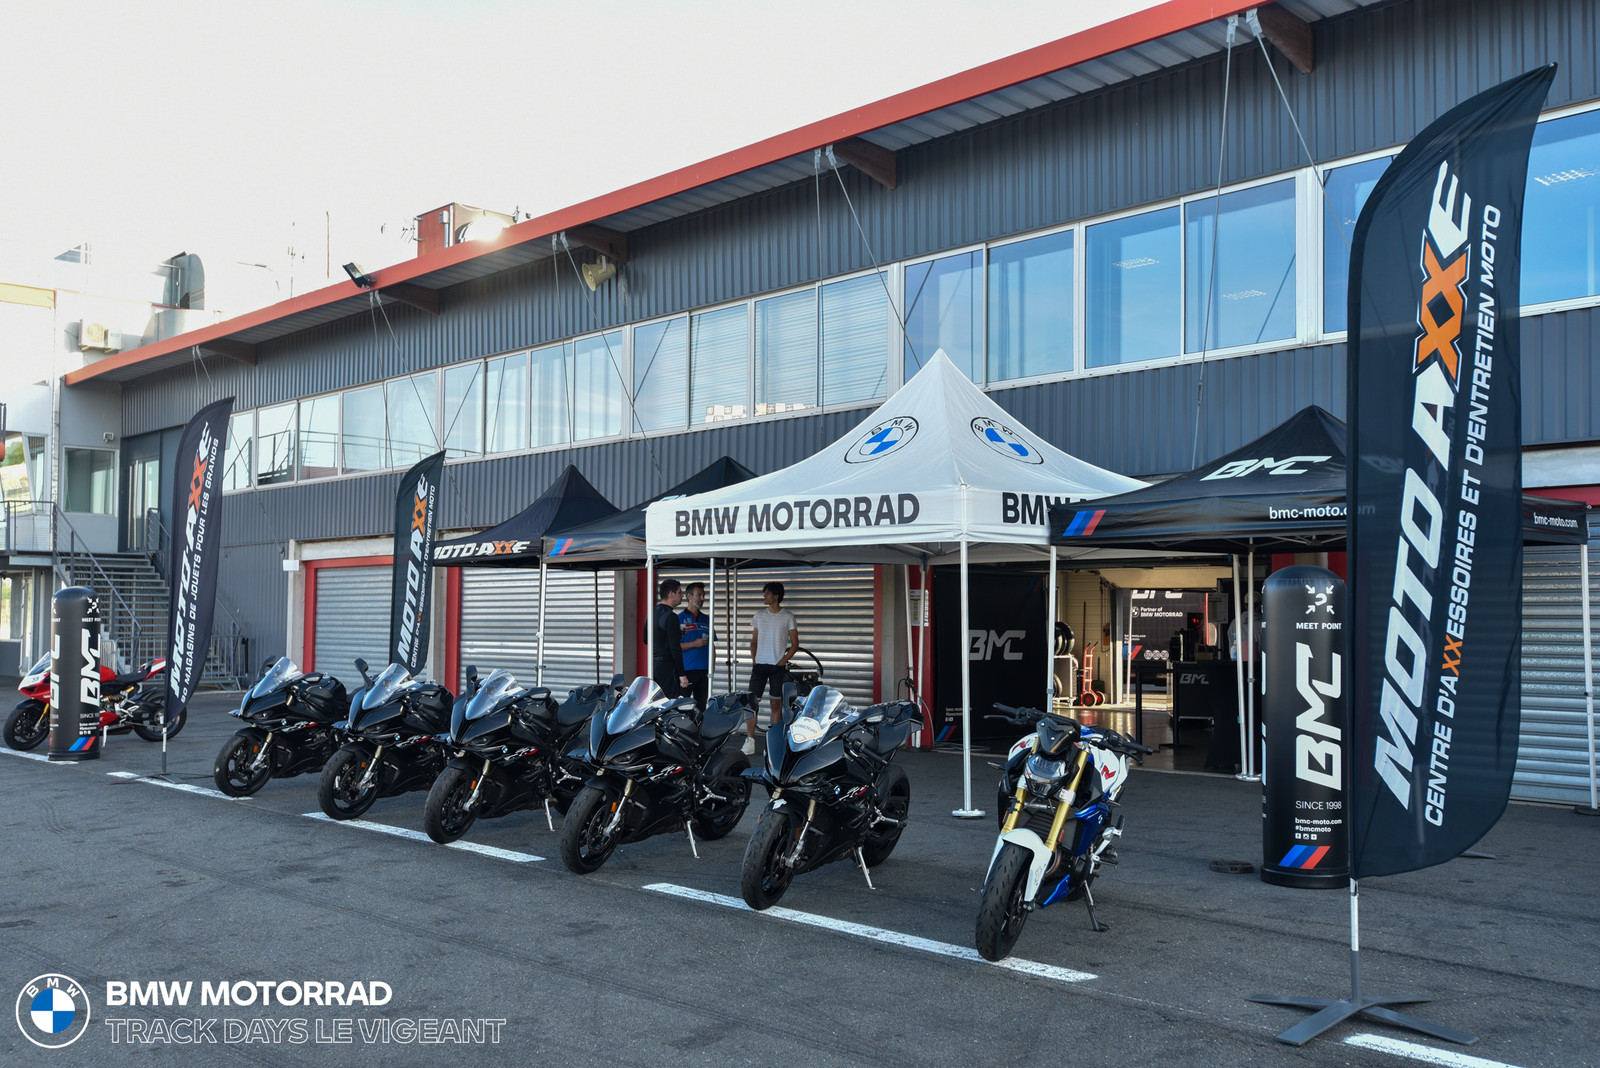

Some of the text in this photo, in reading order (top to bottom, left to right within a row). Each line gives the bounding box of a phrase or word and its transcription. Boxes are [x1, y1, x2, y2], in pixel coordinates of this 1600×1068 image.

[204, 438, 219, 490] GRANDS
[1200, 455, 1332, 482] BMC
[428, 484, 436, 510] MOTO
[1374, 467, 1443, 811] MOTO
[1411, 160, 1472, 472] AXXE
[201, 491, 210, 516] LES
[675, 493, 920, 537] BMW MOTORRAD
[1425, 204, 1502, 827] CENTRE D'AXXESSOIRES ET D'ENTRETIEN MOTO
[195, 517, 206, 552] POUR
[1533, 512, 1579, 529] bmc-moto.com
[190, 553, 202, 601] JOUETS
[397, 473, 429, 664] MOTO AXXE
[189, 602, 197, 621] DE
[1296, 622, 1342, 630] MEET POINT
[184, 622, 195, 686] MAGASINS
[1296, 641, 1342, 791] BMC
[1295, 800, 1342, 810] SINCE 1998
[1295, 817, 1342, 825] bmc-moto.com
[1295, 825, 1332, 833] #bmcmoto
